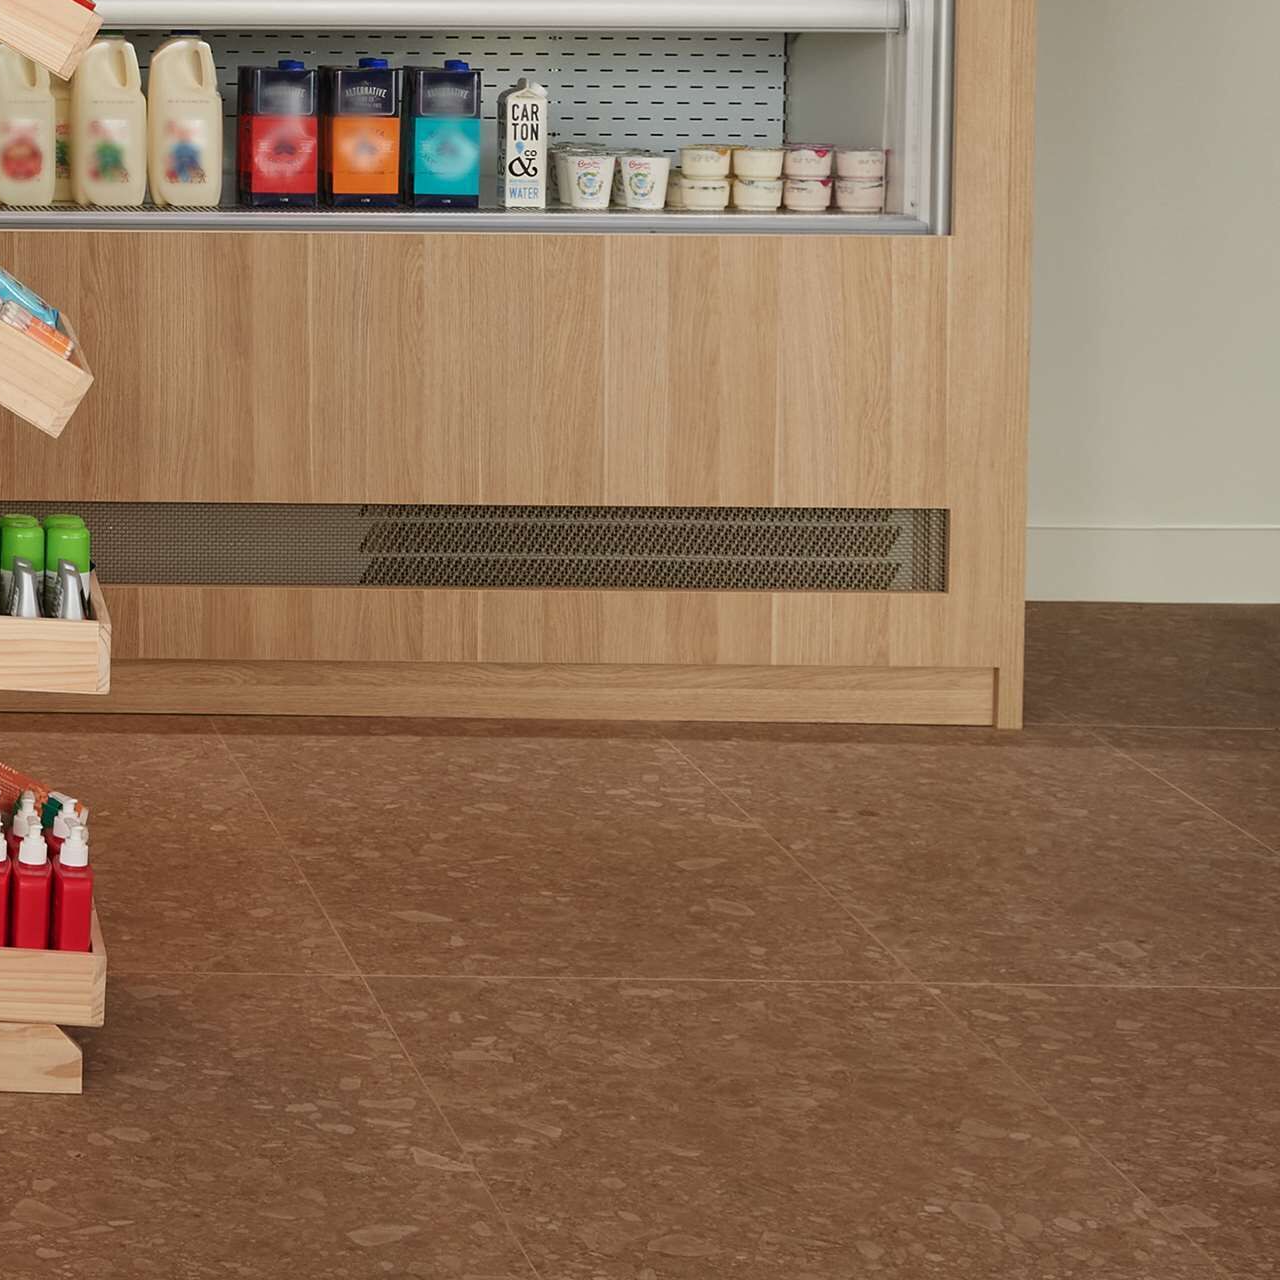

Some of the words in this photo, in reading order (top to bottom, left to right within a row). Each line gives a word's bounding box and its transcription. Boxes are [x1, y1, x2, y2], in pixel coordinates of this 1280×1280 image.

[511, 103, 540, 122] CAR
[511, 122, 540, 142] TON
[524, 149, 538, 157] CO
[507, 156, 539, 178] &
[509, 186, 540, 200] WATER
